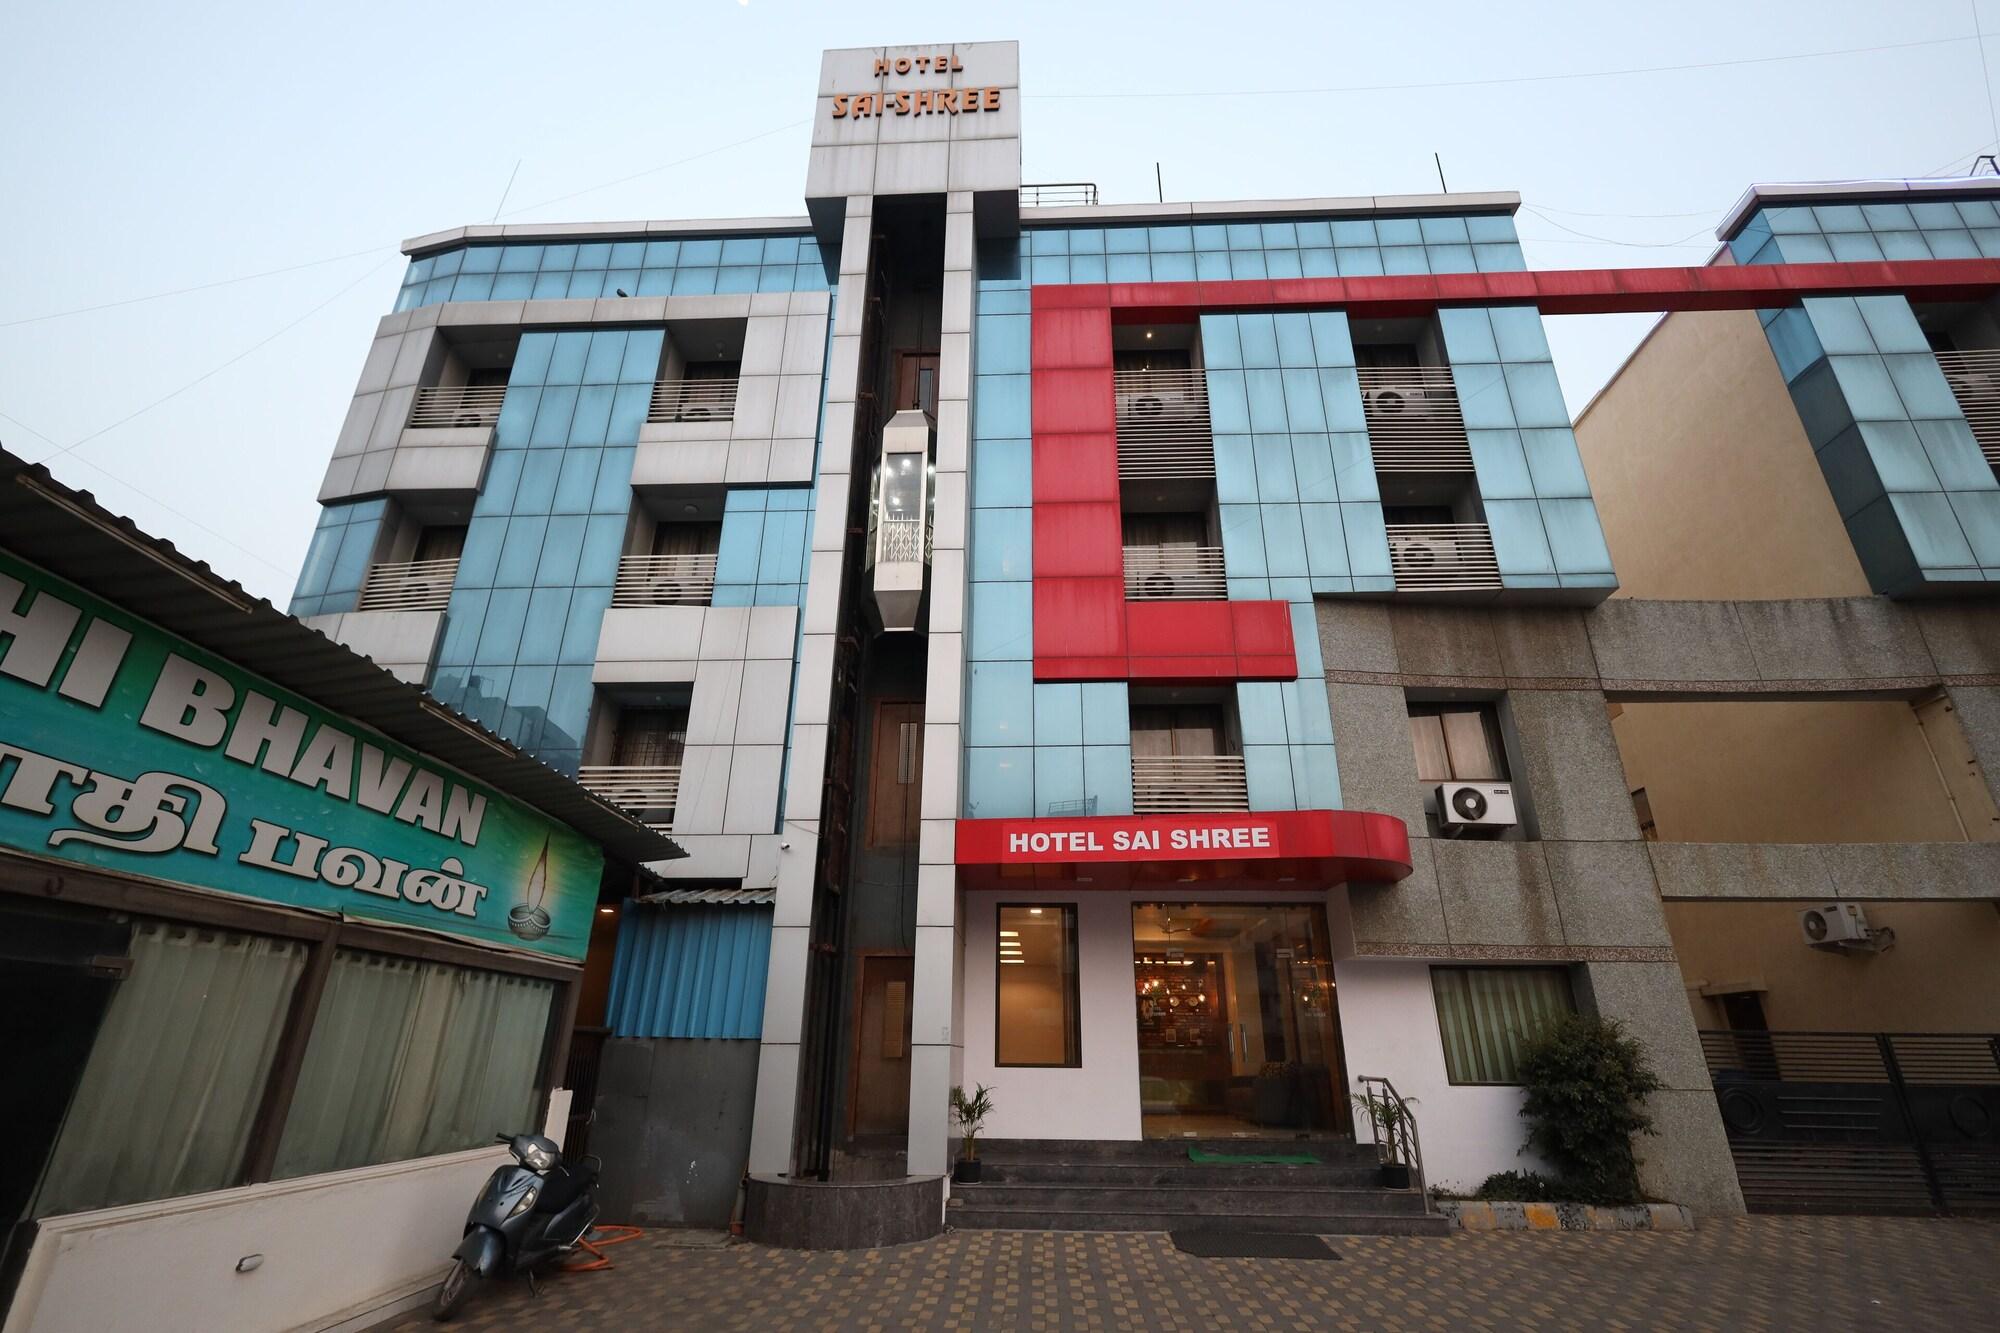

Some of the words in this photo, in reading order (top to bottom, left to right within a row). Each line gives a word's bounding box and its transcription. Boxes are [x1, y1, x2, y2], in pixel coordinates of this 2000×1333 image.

[874, 55, 963, 78] HOTEL
[832, 86, 1000, 120] SAI-SHREE
[139, 652, 488, 848] BHAVAN
[1009, 831, 1104, 853] HOTEL
[1113, 829, 1160, 851] SAI
[1170, 827, 1270, 850] SHREE
[238, 818, 489, 918] பவன்
